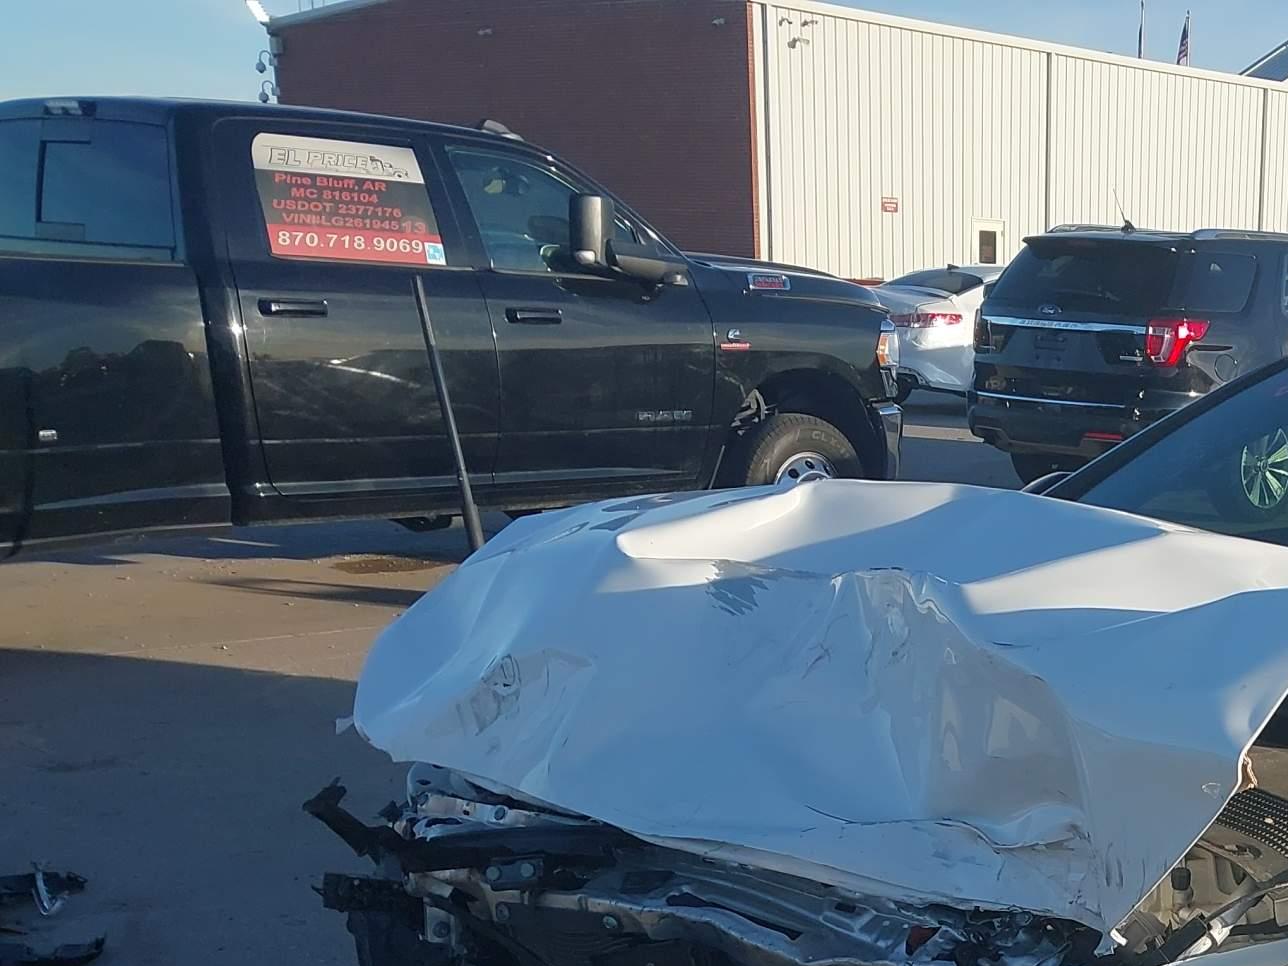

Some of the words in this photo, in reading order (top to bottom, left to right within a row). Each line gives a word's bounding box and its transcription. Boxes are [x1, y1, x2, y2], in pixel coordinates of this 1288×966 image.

[269, 147, 302, 166] EL
[274, 173, 311, 186] Pine
[316, 176, 360, 191] Bluff,
[362, 180, 387, 192] AR
[290, 187, 318, 198] MC
[322, 190, 379, 204] 816104
[272, 199, 334, 213] USDOT
[338, 203, 402, 219] 2377176
[401, 219, 427, 234] 13
[278, 231, 424, 253] 870.718.9069
